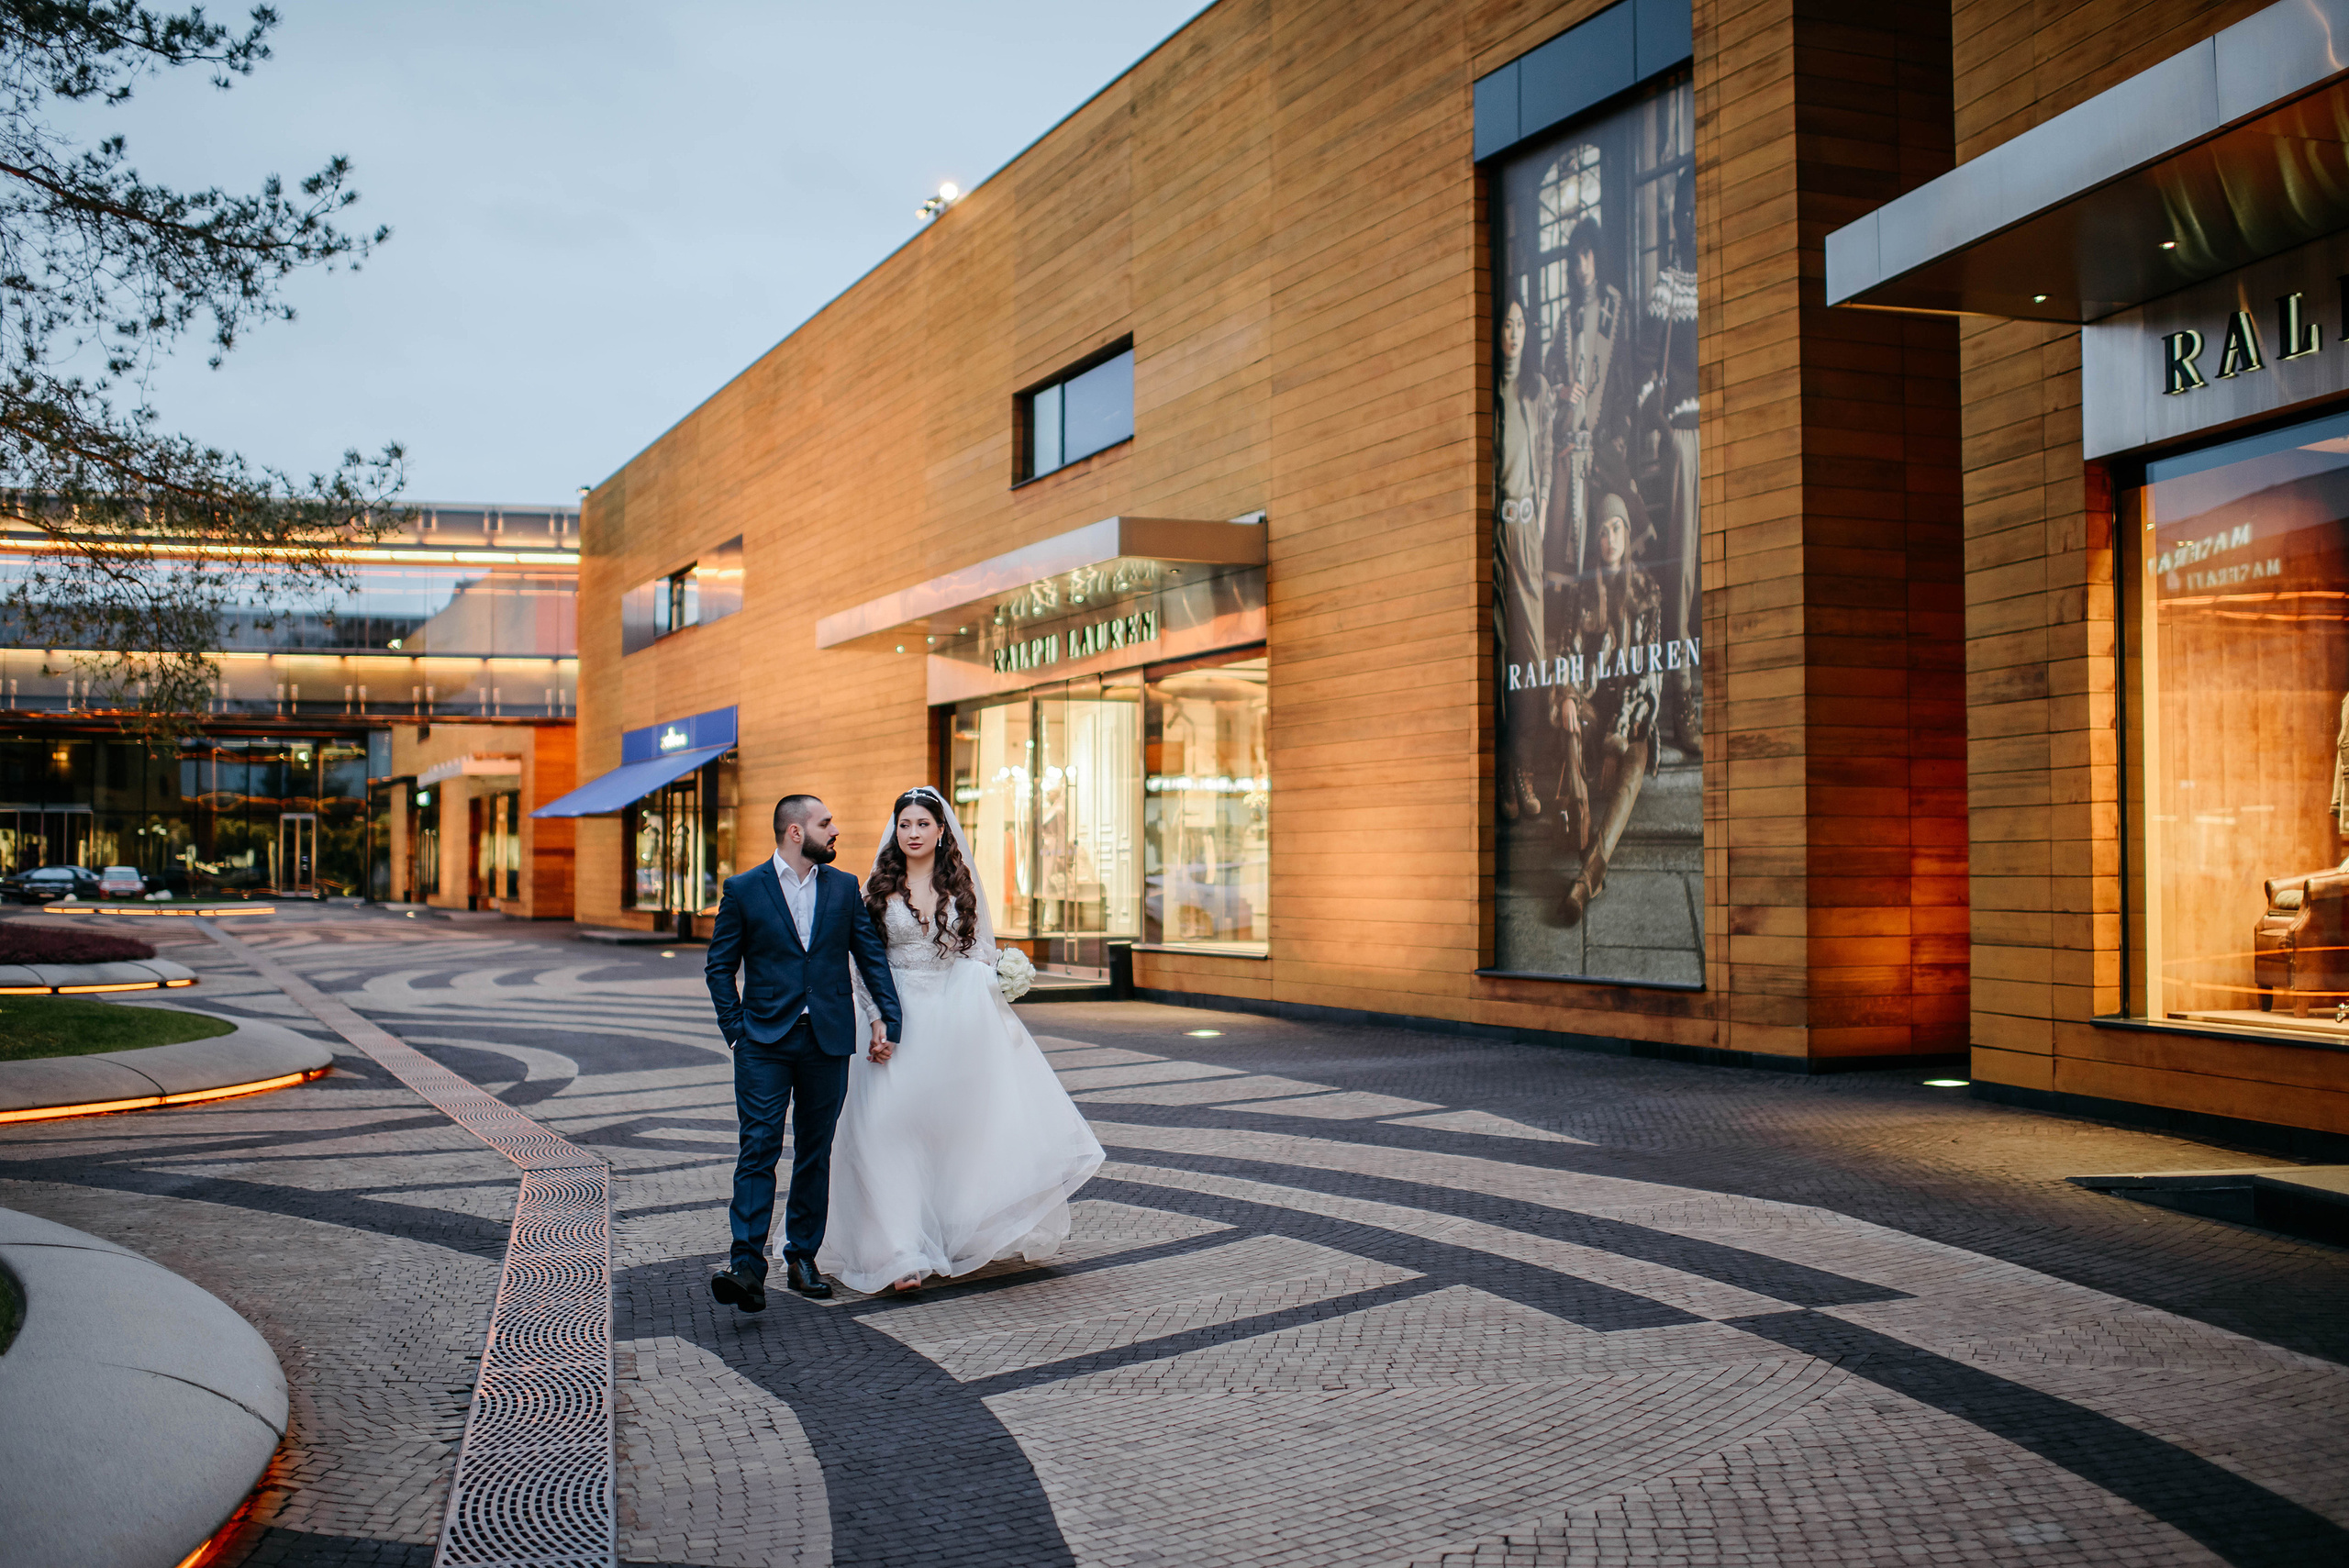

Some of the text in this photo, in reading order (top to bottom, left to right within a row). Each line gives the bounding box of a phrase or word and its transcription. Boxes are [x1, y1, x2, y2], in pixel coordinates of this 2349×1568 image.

[2161, 273, 2349, 395] RAL
[994, 610, 1159, 673] RALPH LAUREN
[1508, 637, 1701, 691] RALPH LAUREN
